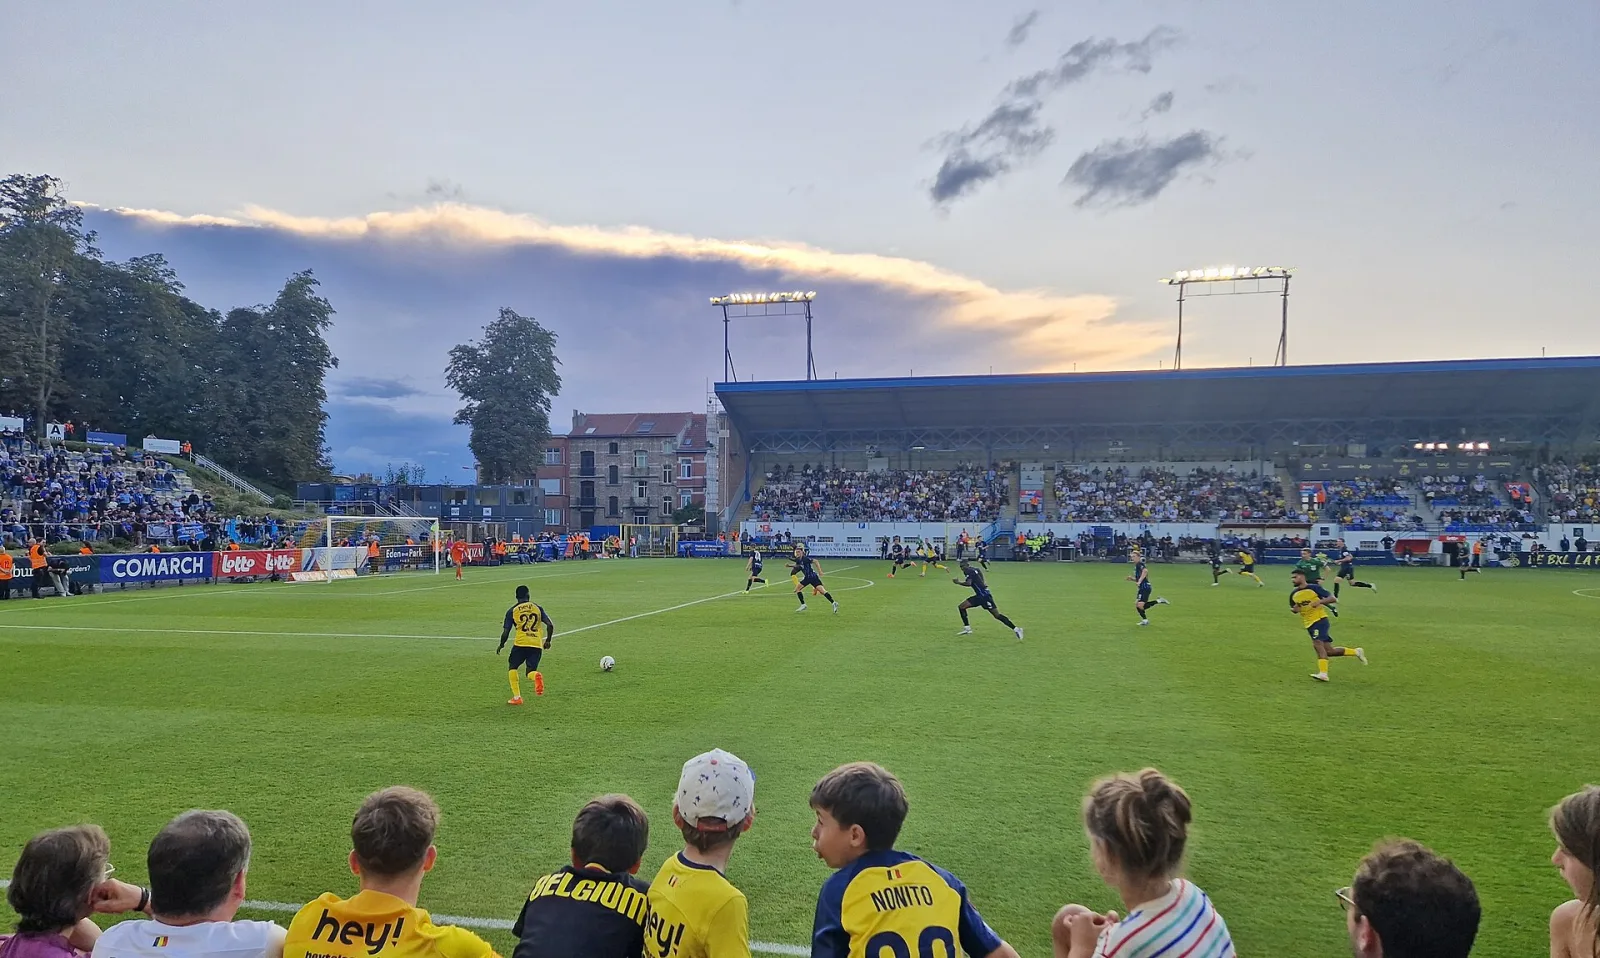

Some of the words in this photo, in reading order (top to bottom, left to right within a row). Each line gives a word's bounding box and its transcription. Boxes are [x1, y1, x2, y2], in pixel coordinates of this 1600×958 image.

[51, 425, 60, 434] A
[386, 549, 401, 558] Eden
[409, 548, 422, 557] Park
[1547, 554, 1570, 565] BXL
[1575, 555, 1592, 565] LA
[112, 556, 204, 578] COMARCH
[520, 613, 538, 632] 22
[529, 872, 648, 926] BELGIUM
[870, 885, 933, 912] NONITO
[312, 909, 405, 955] hey!
